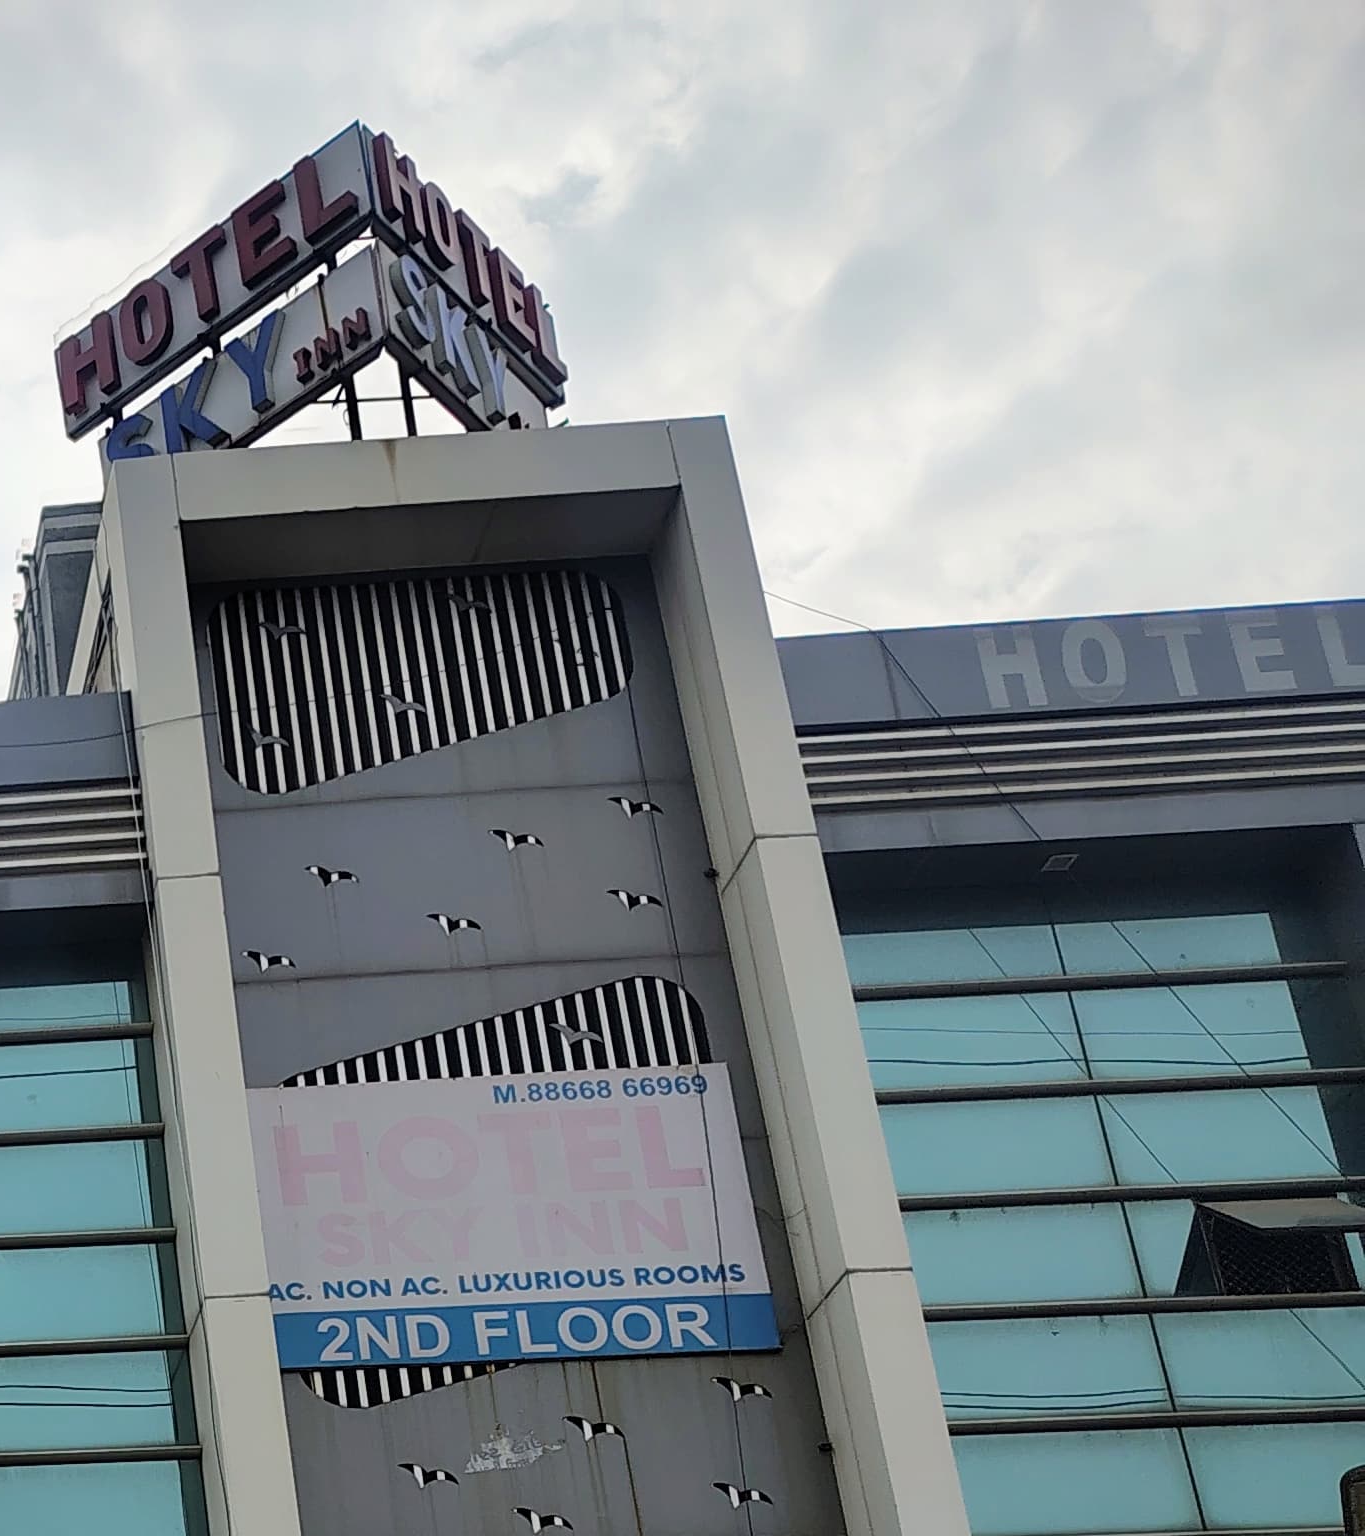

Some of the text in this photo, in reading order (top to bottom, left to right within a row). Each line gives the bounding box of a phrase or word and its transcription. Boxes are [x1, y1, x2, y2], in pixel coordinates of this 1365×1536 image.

[56, 155, 359, 417] HOTEL
[372, 131, 568, 386] HOTEL
[293, 308, 371, 385] INN
[389, 255, 508, 427] SKY
[975, 603, 1365, 710] HOTEL
[493, 1074, 709, 1104] M.88668 66969
[273, 1104, 707, 1208] HOTEL
[316, 1197, 690, 1268] SKY INN
[323, 1278, 392, 1300] NON
[401, 1275, 449, 1297] AC.
[458, 1269, 625, 1295] LUXURIOUS
[634, 1263, 746, 1287] ROOMS
[316, 1302, 717, 1362] 2ND FLOOR
